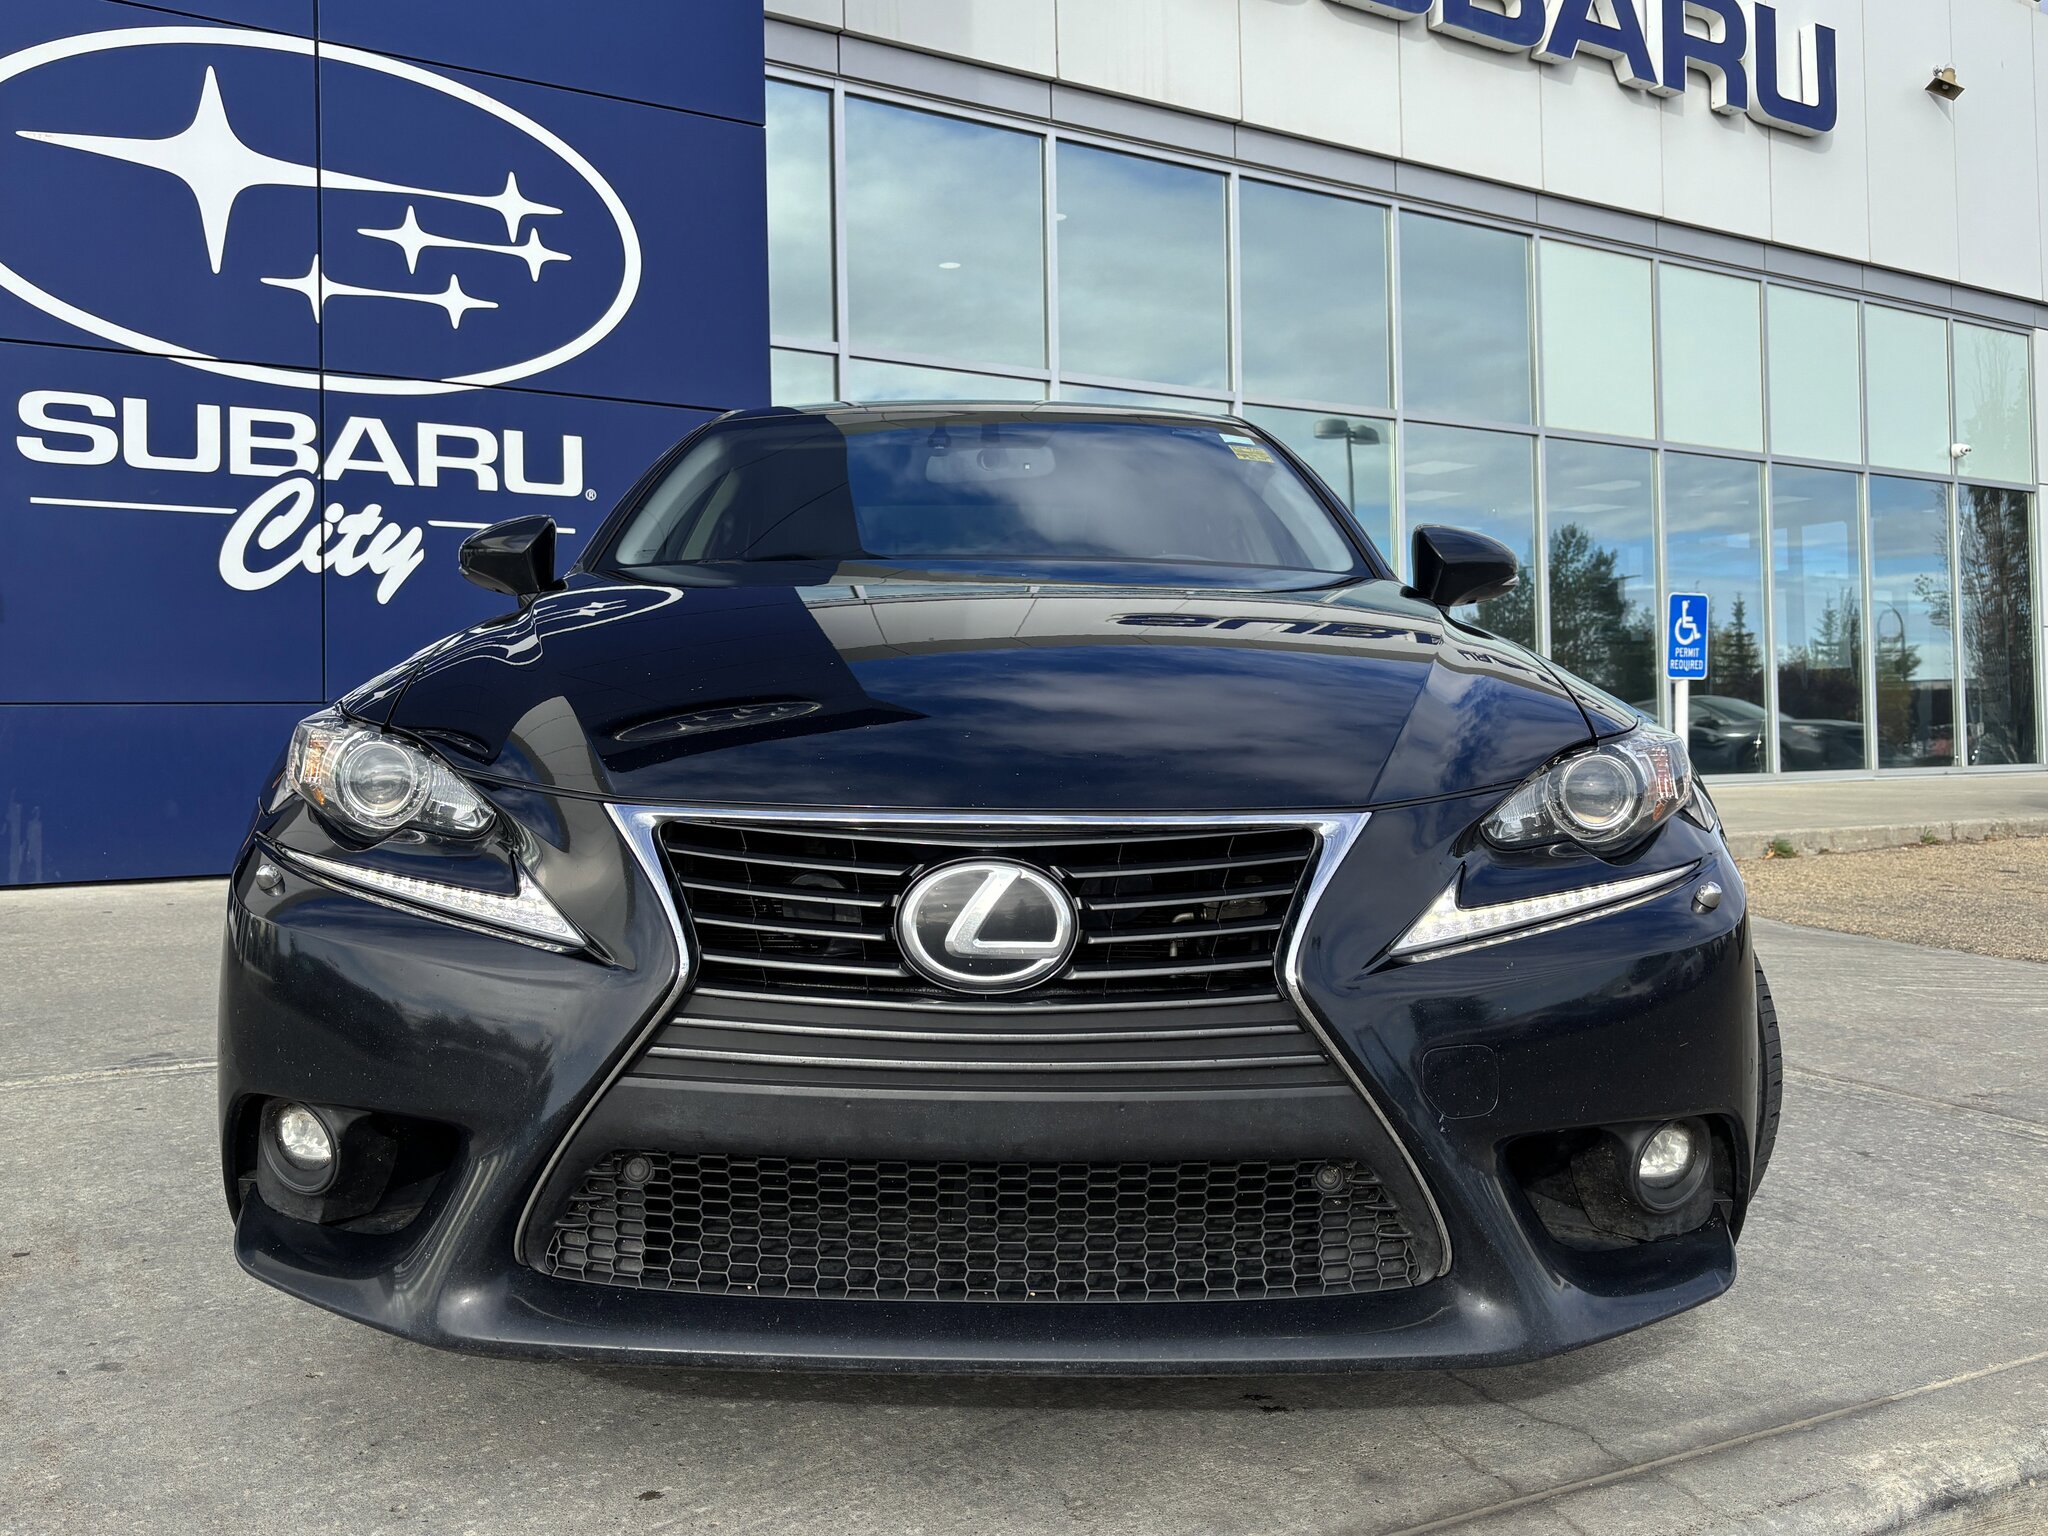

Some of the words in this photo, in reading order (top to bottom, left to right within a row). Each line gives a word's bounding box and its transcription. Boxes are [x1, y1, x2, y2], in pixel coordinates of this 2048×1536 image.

[1322, 0, 1839, 137] ARU
[218, 477, 425, 605] City
[1670, 659, 1704, 671] REQUIRED
[1675, 647, 1700, 658] PERMIT
